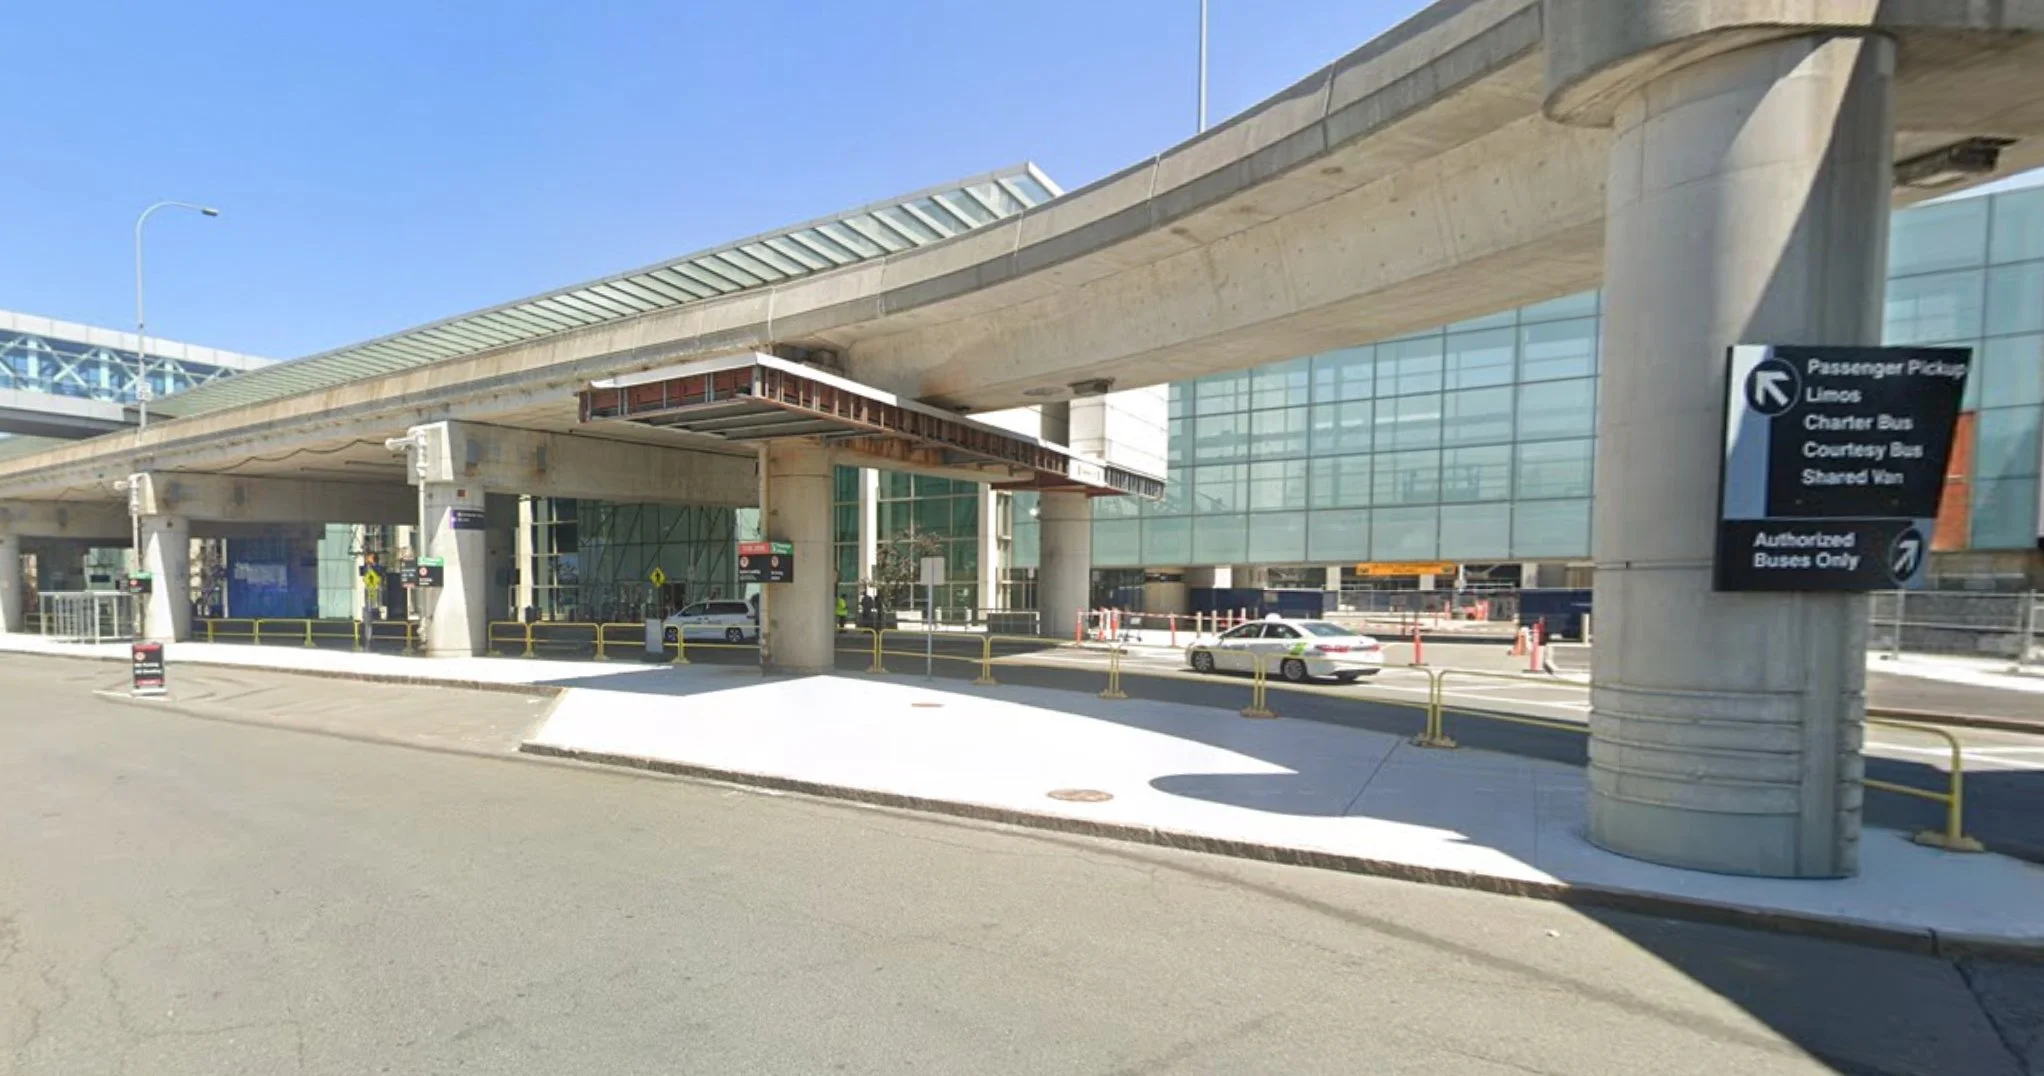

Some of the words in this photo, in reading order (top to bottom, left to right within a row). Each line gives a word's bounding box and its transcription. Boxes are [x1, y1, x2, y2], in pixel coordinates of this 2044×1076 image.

[1808, 358, 1904, 380] Passenger
[1907, 359, 1966, 380] Pickup
[1805, 386, 1862, 403] Limos
[1804, 414, 1874, 431] Charter
[1877, 413, 1914, 431] Bus
[1803, 441, 1887, 461] Courtesy
[1889, 441, 1924, 458] Bus
[1802, 468, 1869, 485] Shared
[1871, 469, 1904, 485] Van
[1752, 531, 1856, 548] Authorized
[1754, 552, 1811, 568] Buses
[1815, 551, 1860, 571] Only
